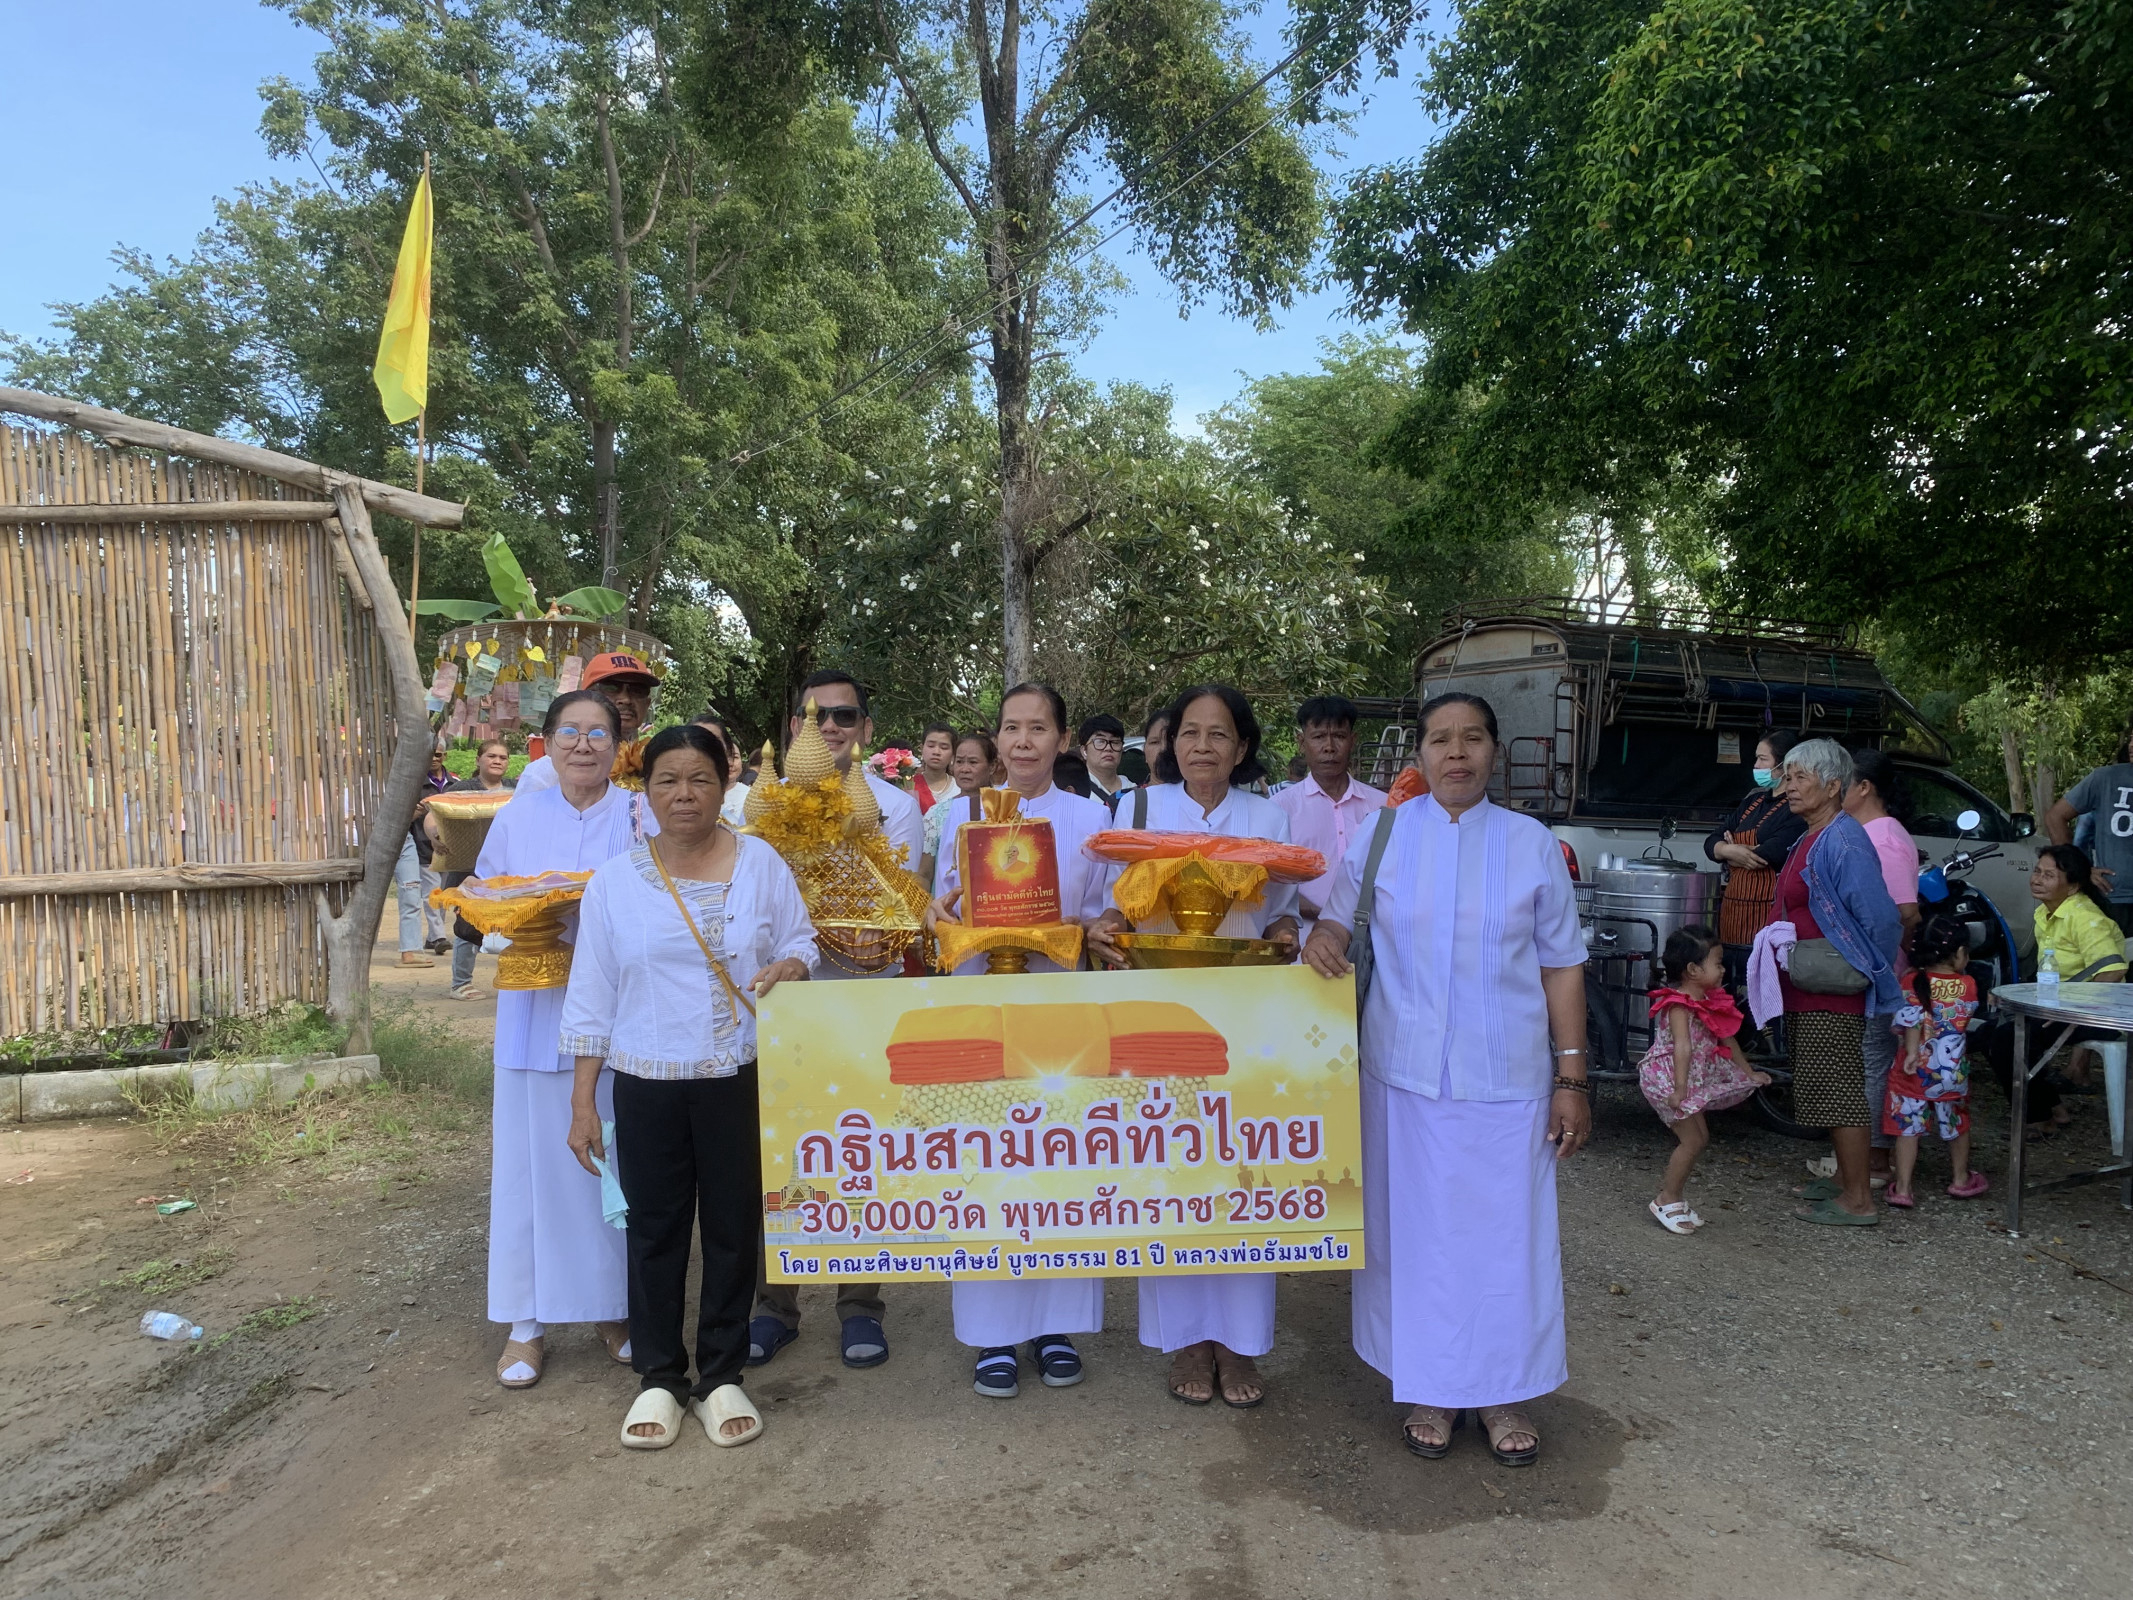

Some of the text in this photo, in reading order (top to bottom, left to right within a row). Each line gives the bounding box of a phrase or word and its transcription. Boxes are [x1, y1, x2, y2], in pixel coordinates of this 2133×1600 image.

[800, 1086, 1320, 1192] กฐินสามัคคีทั่วไทย
[1001, 1185, 1213, 1242] พุทธศักราช
[1228, 1188, 1326, 1222] 2568
[780, 1237, 1349, 1277] โดย คณะศิษยานุศิษย์ บูชาธรรม 81 ปี หลวงพ่อธัมมชโย
